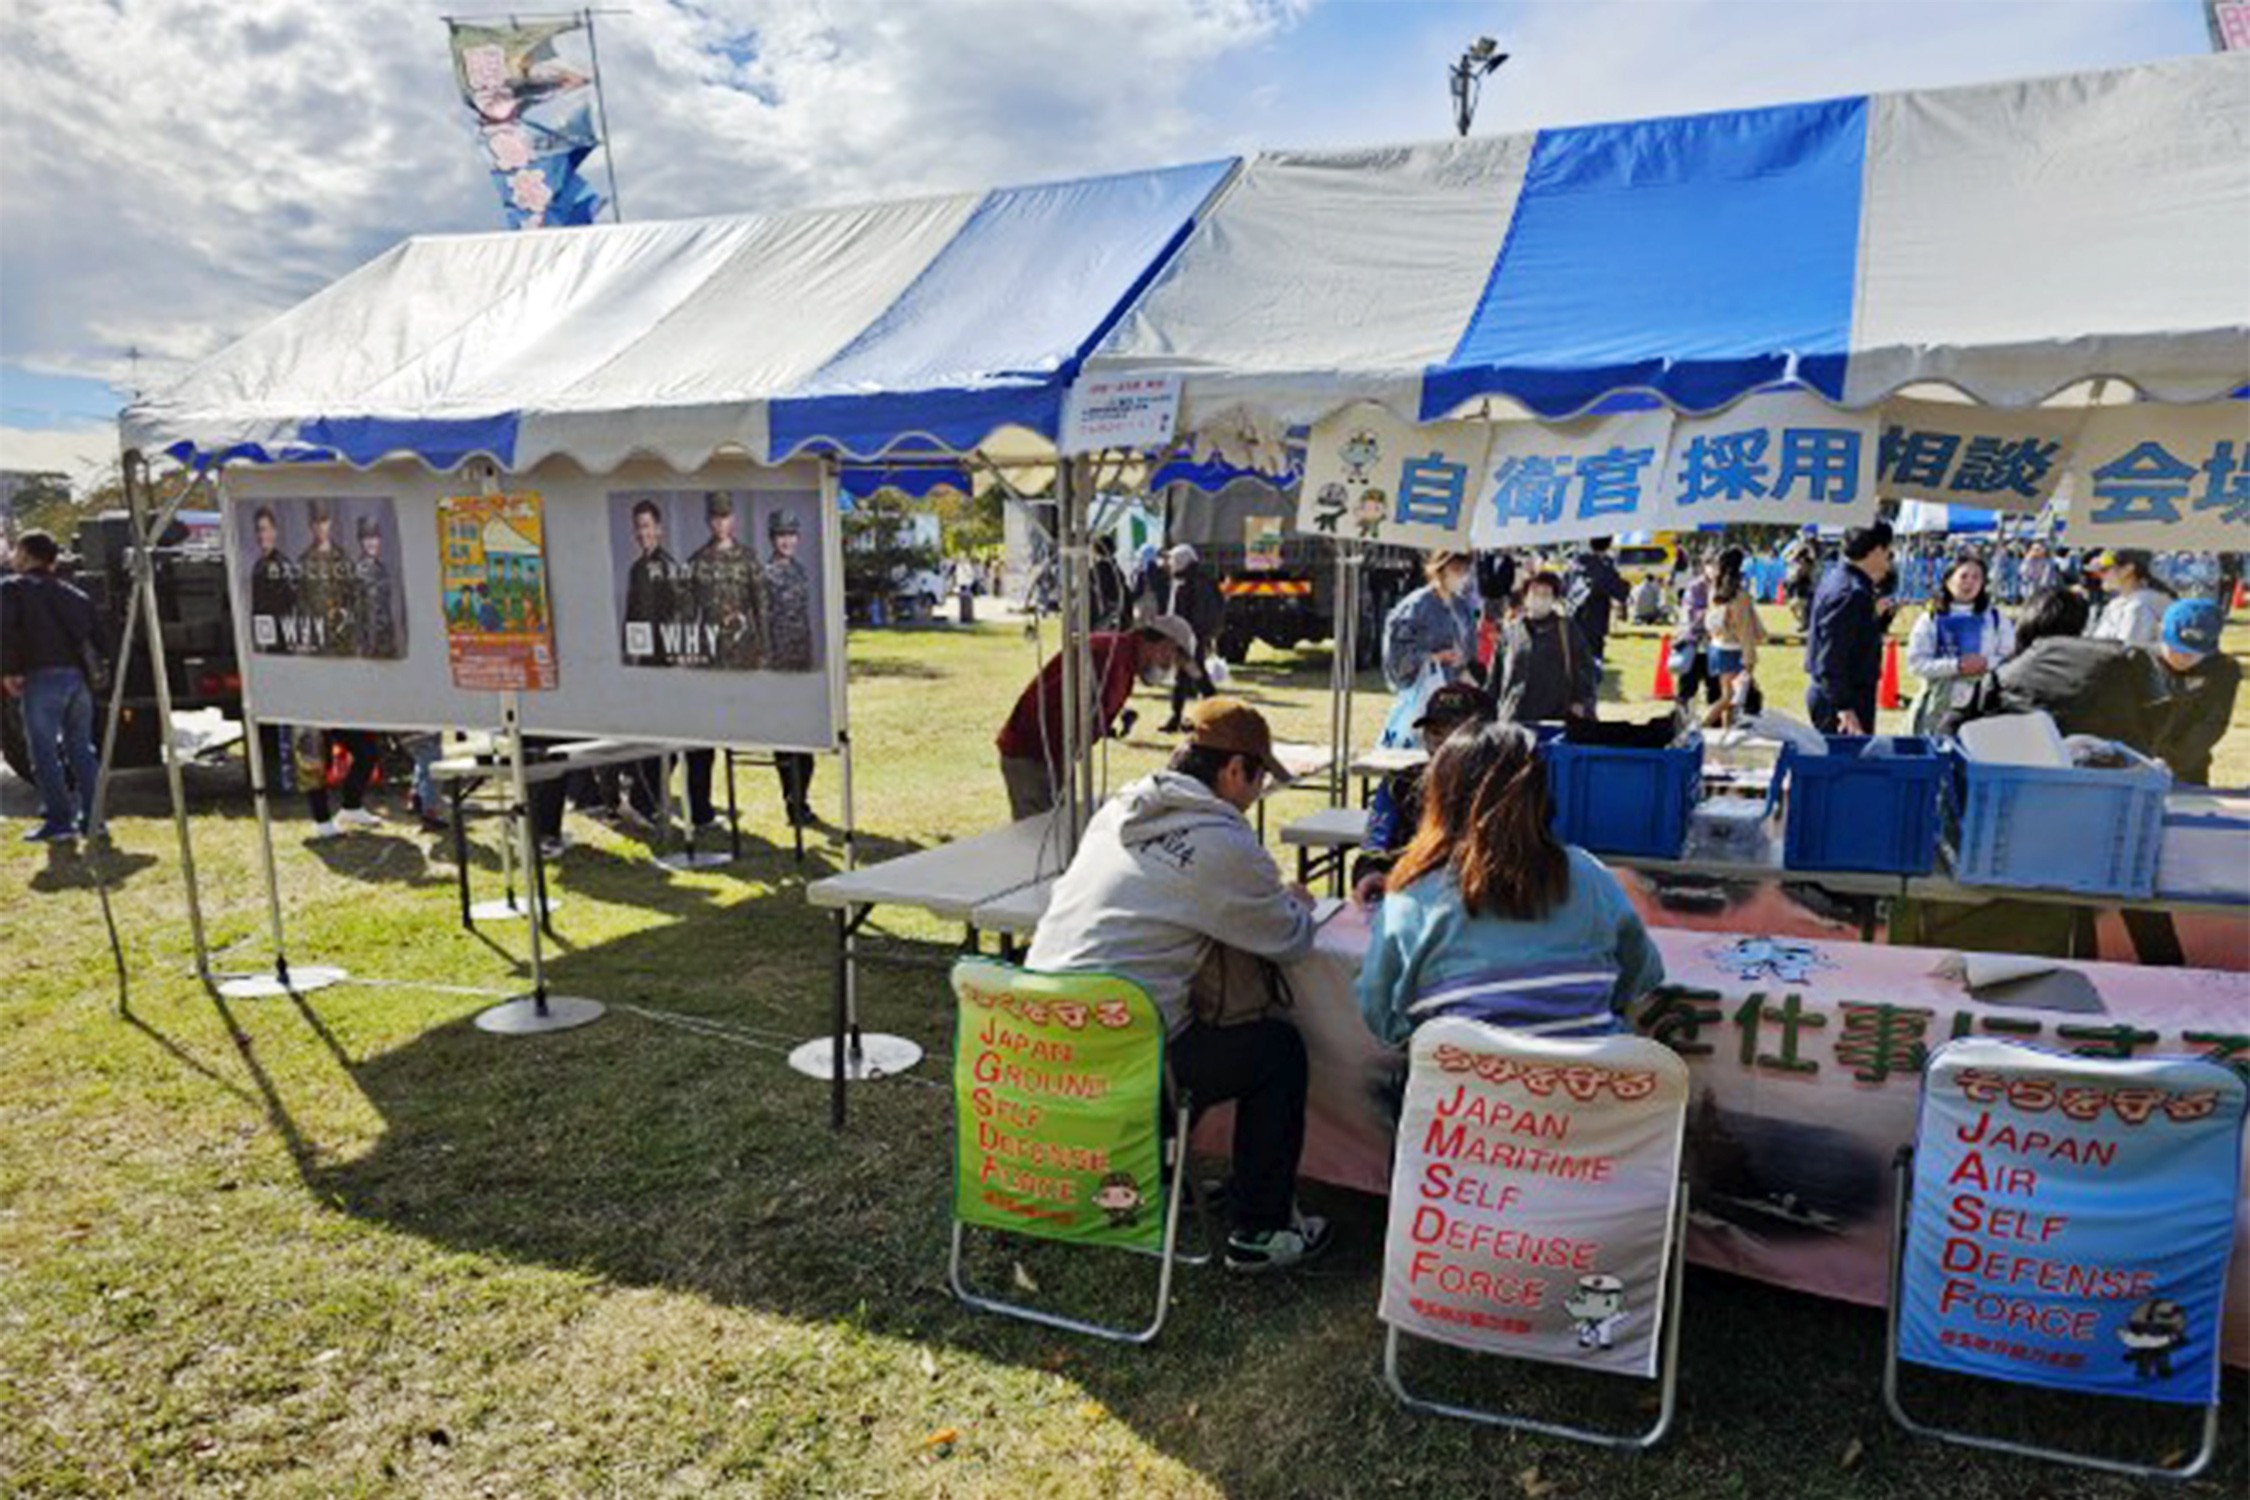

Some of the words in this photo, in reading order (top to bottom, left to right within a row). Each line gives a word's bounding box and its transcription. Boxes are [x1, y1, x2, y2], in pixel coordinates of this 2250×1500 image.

[1436, 1085, 1570, 1140] JAPAN
[1957, 1112, 2118, 1168] JAPAN
[1423, 1119, 1615, 1182] MARITIME
[1949, 1151, 2036, 1197] AIR
[1419, 1164, 1522, 1212] SELF
[1411, 1205, 1600, 1271] DEFENSE
[1946, 1194, 2069, 1243] SELF
[1409, 1252, 1547, 1308] FORCE
[1939, 1238, 2158, 1300] DEFENSE
[1939, 1279, 2098, 1340] FORCE
